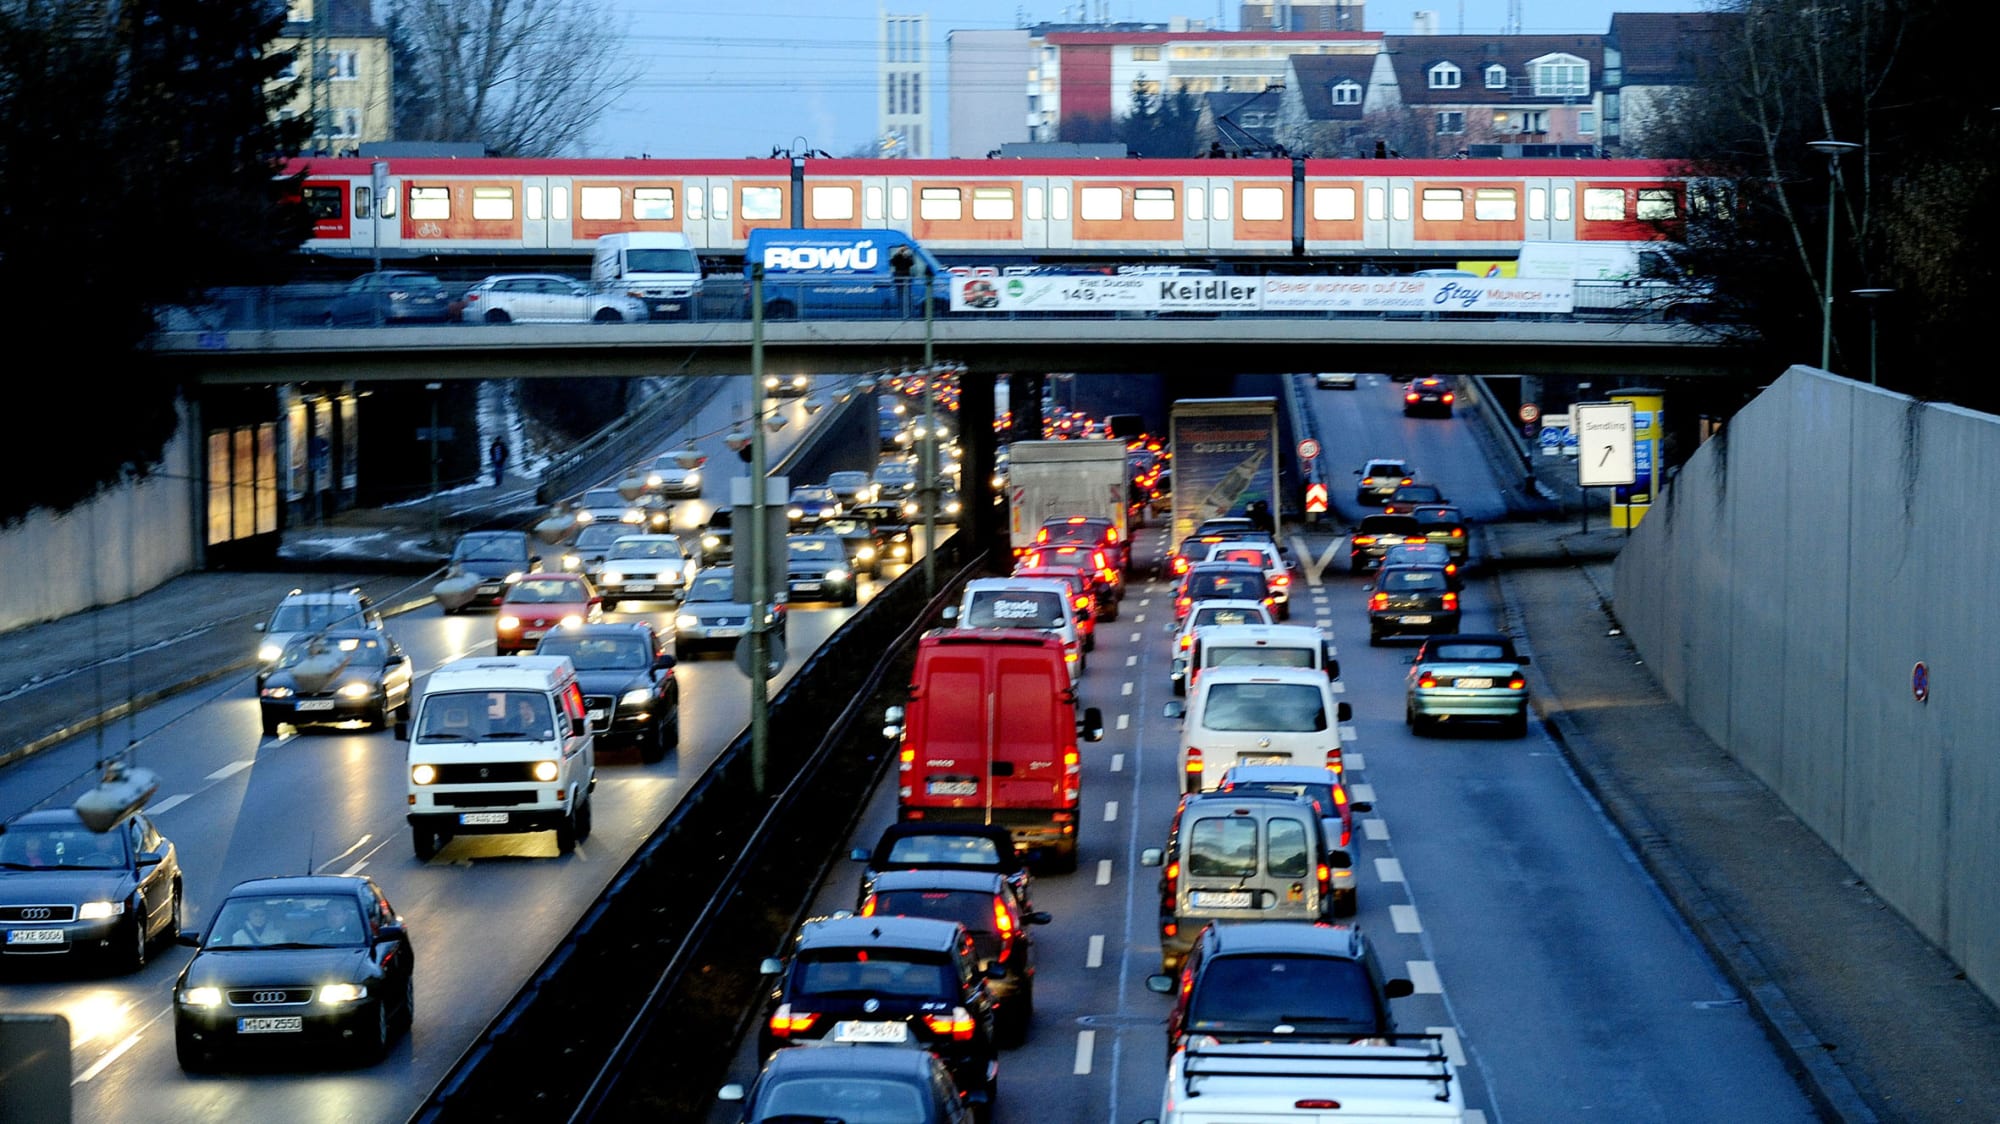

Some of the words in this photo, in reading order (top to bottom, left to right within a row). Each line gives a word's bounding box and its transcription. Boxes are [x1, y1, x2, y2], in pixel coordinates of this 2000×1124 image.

[764, 240, 878, 270] ROWÜ
[1161, 280, 1257, 300] Keidler
[1266, 281, 1310, 293] Clever
[1314, 281, 1369, 293] wohnen
[1374, 281, 1396, 293] auf
[1398, 281, 1425, 293] Zeit
[1434, 282, 1484, 307] Stay
[1487, 289, 1542, 300] MUNICH
[1585, 422, 1626, 432] Sendling
[1192, 442, 1256, 453] QUELLE
